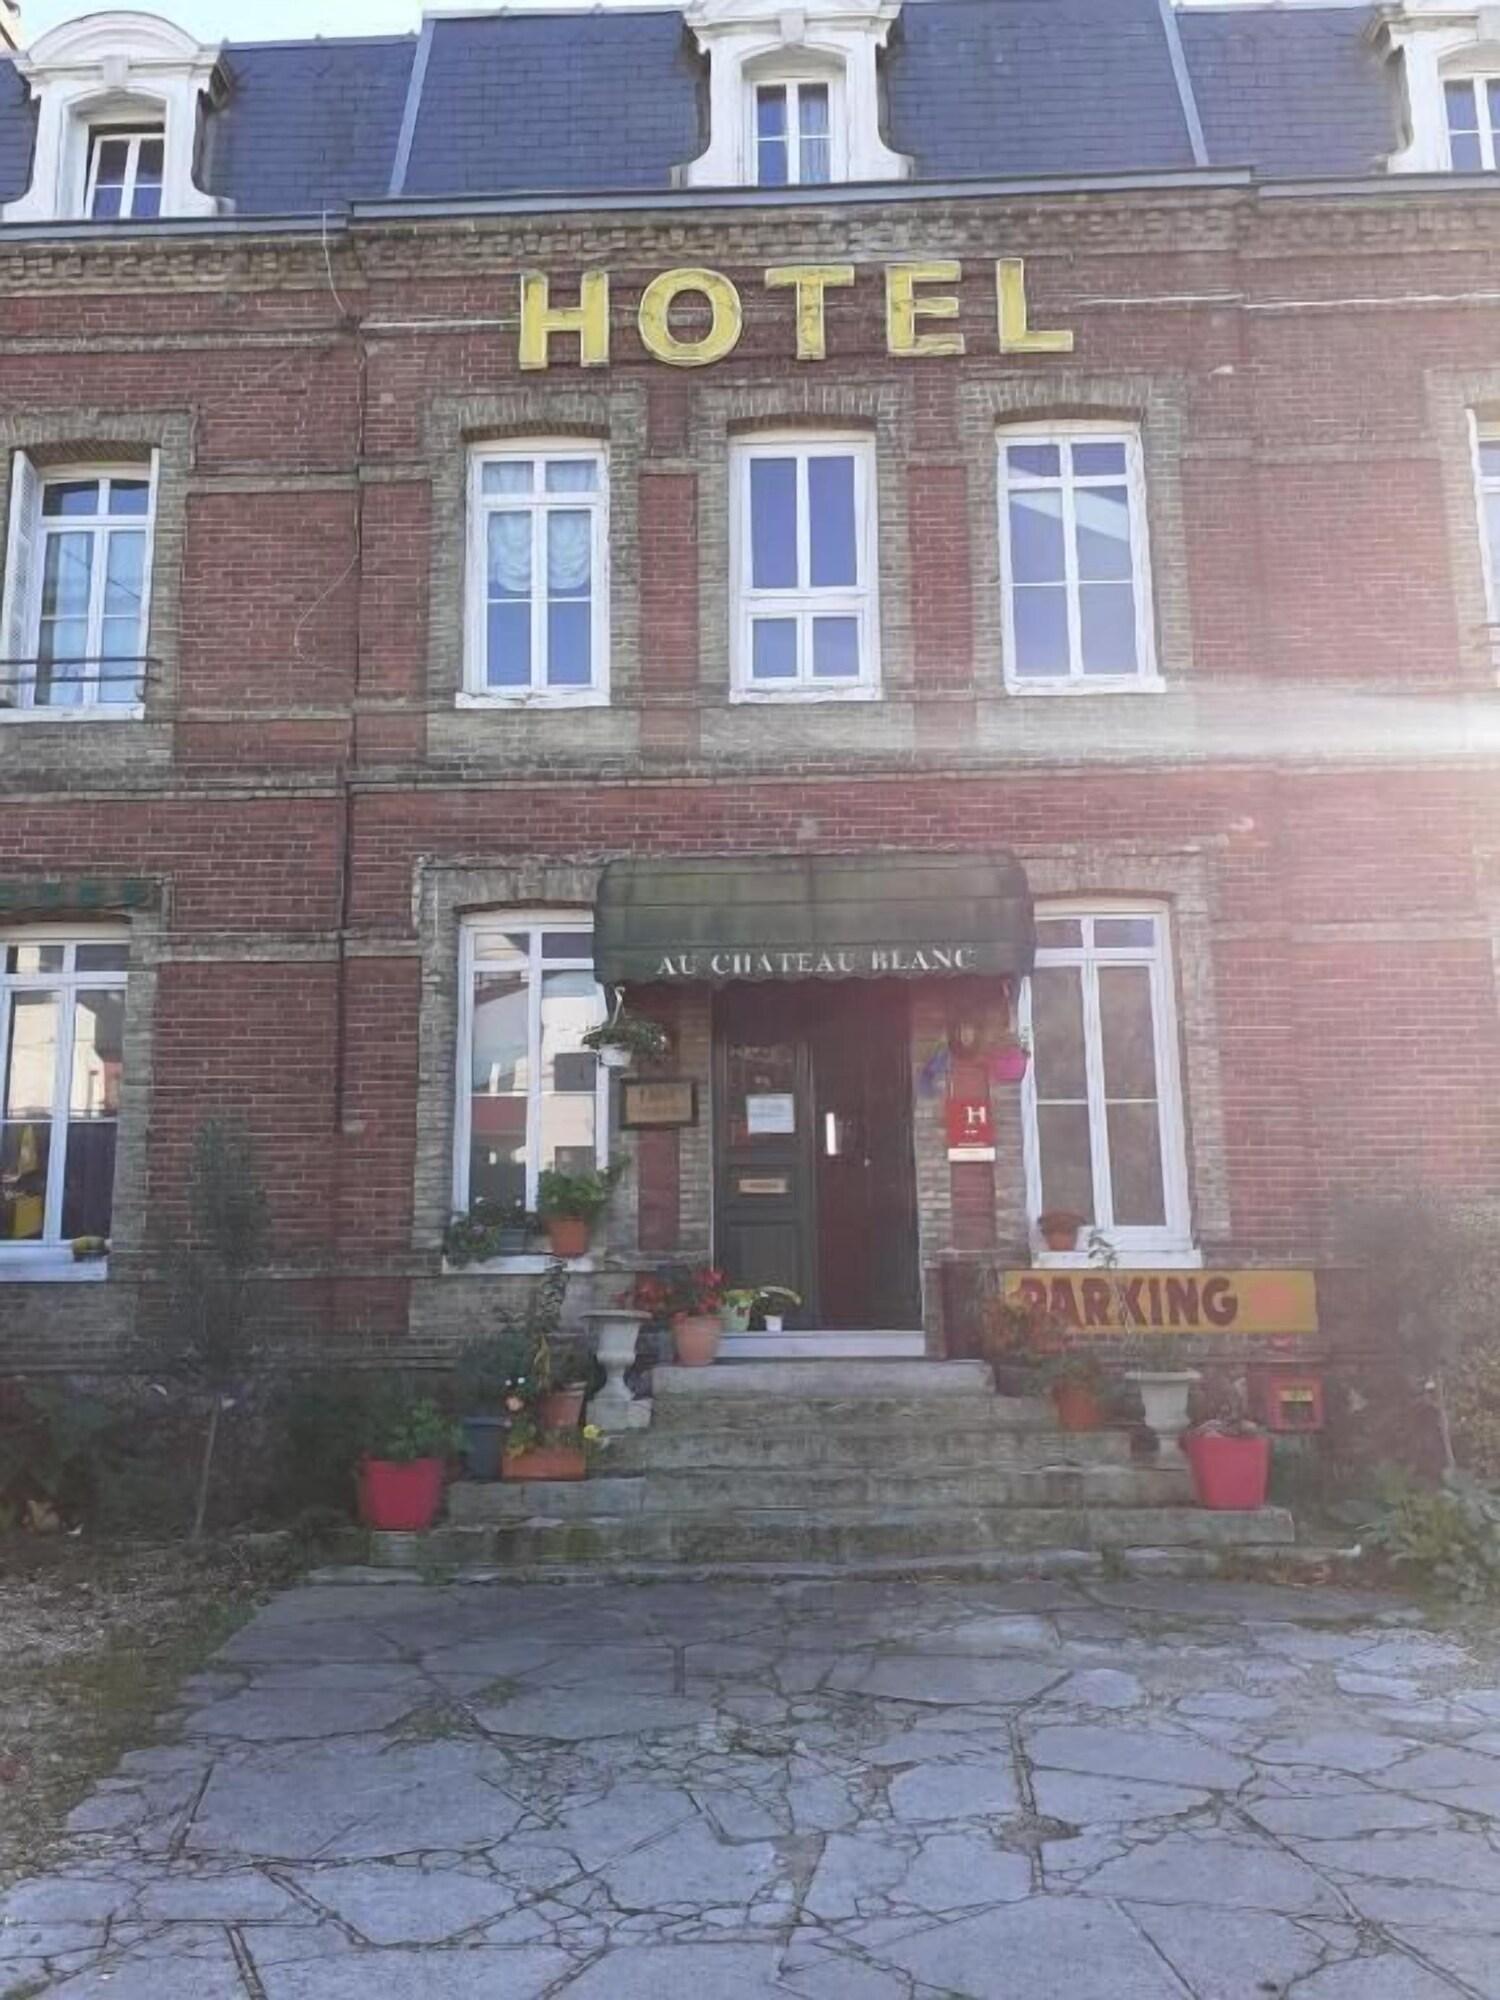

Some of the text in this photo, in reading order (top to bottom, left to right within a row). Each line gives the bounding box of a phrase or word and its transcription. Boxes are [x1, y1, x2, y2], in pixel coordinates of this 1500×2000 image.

[518, 256, 1075, 371] HOTEL
[655, 948, 977, 976] AU CHATEAU BLANC
[965, 1105, 987, 1124] H
[1020, 1276, 1239, 1328] PARKING
